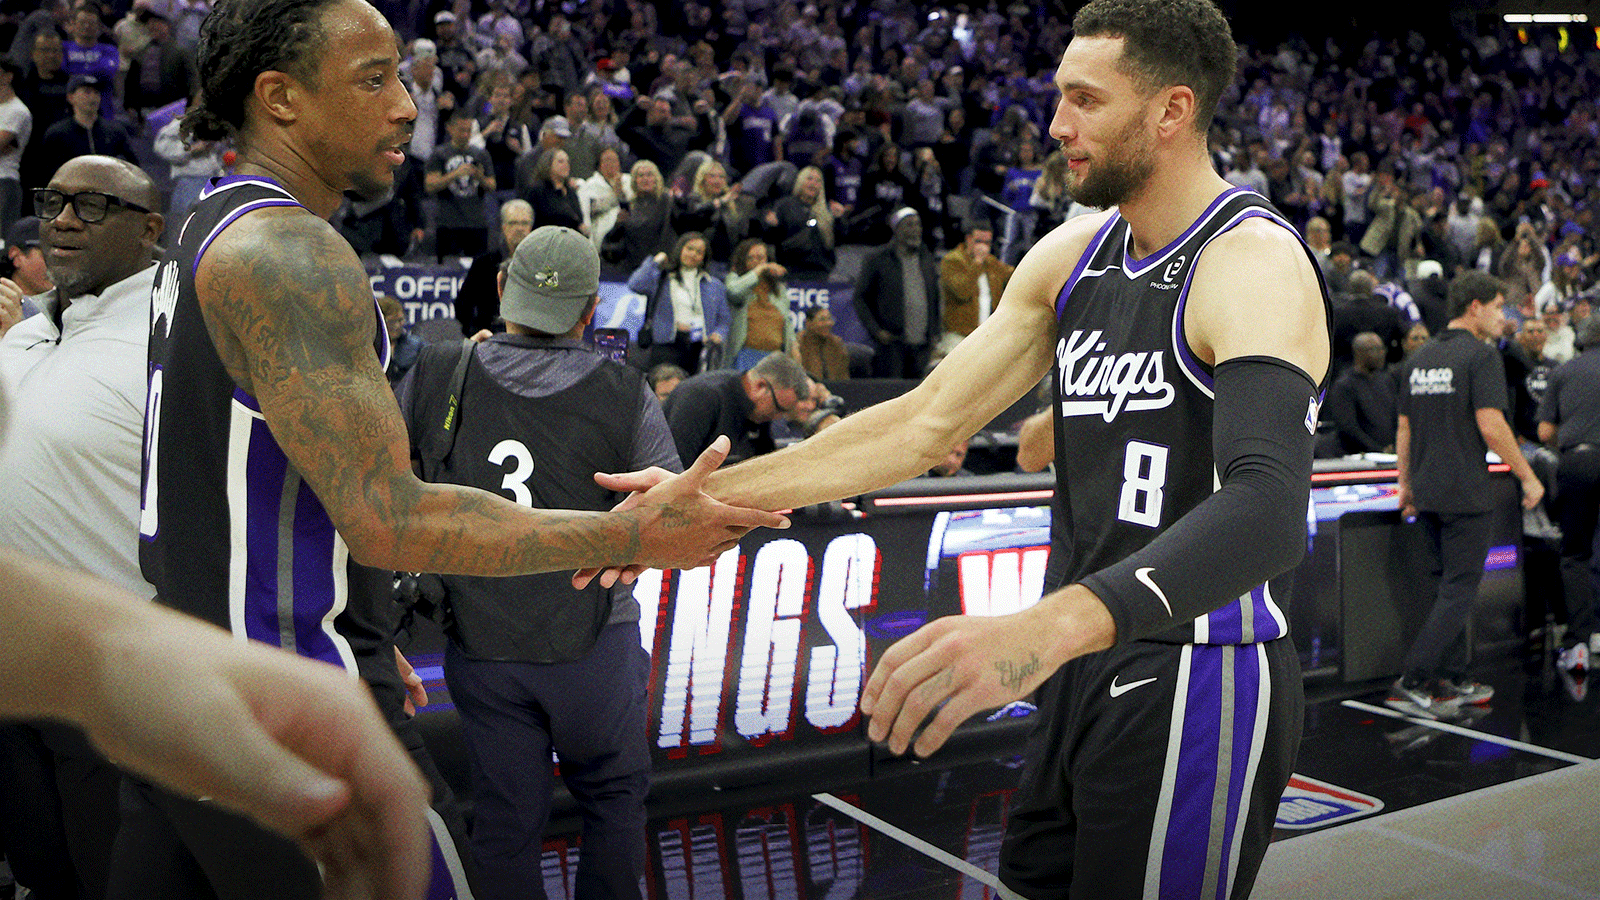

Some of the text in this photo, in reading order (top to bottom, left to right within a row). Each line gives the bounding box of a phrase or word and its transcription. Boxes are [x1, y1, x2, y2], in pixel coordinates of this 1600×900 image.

[394, 275, 464, 299] OFFI
[1056, 330, 1175, 423] Kings
[443, 406, 455, 431] Nikon
[487, 439, 535, 508] 3
[1117, 440, 1170, 528] 8
